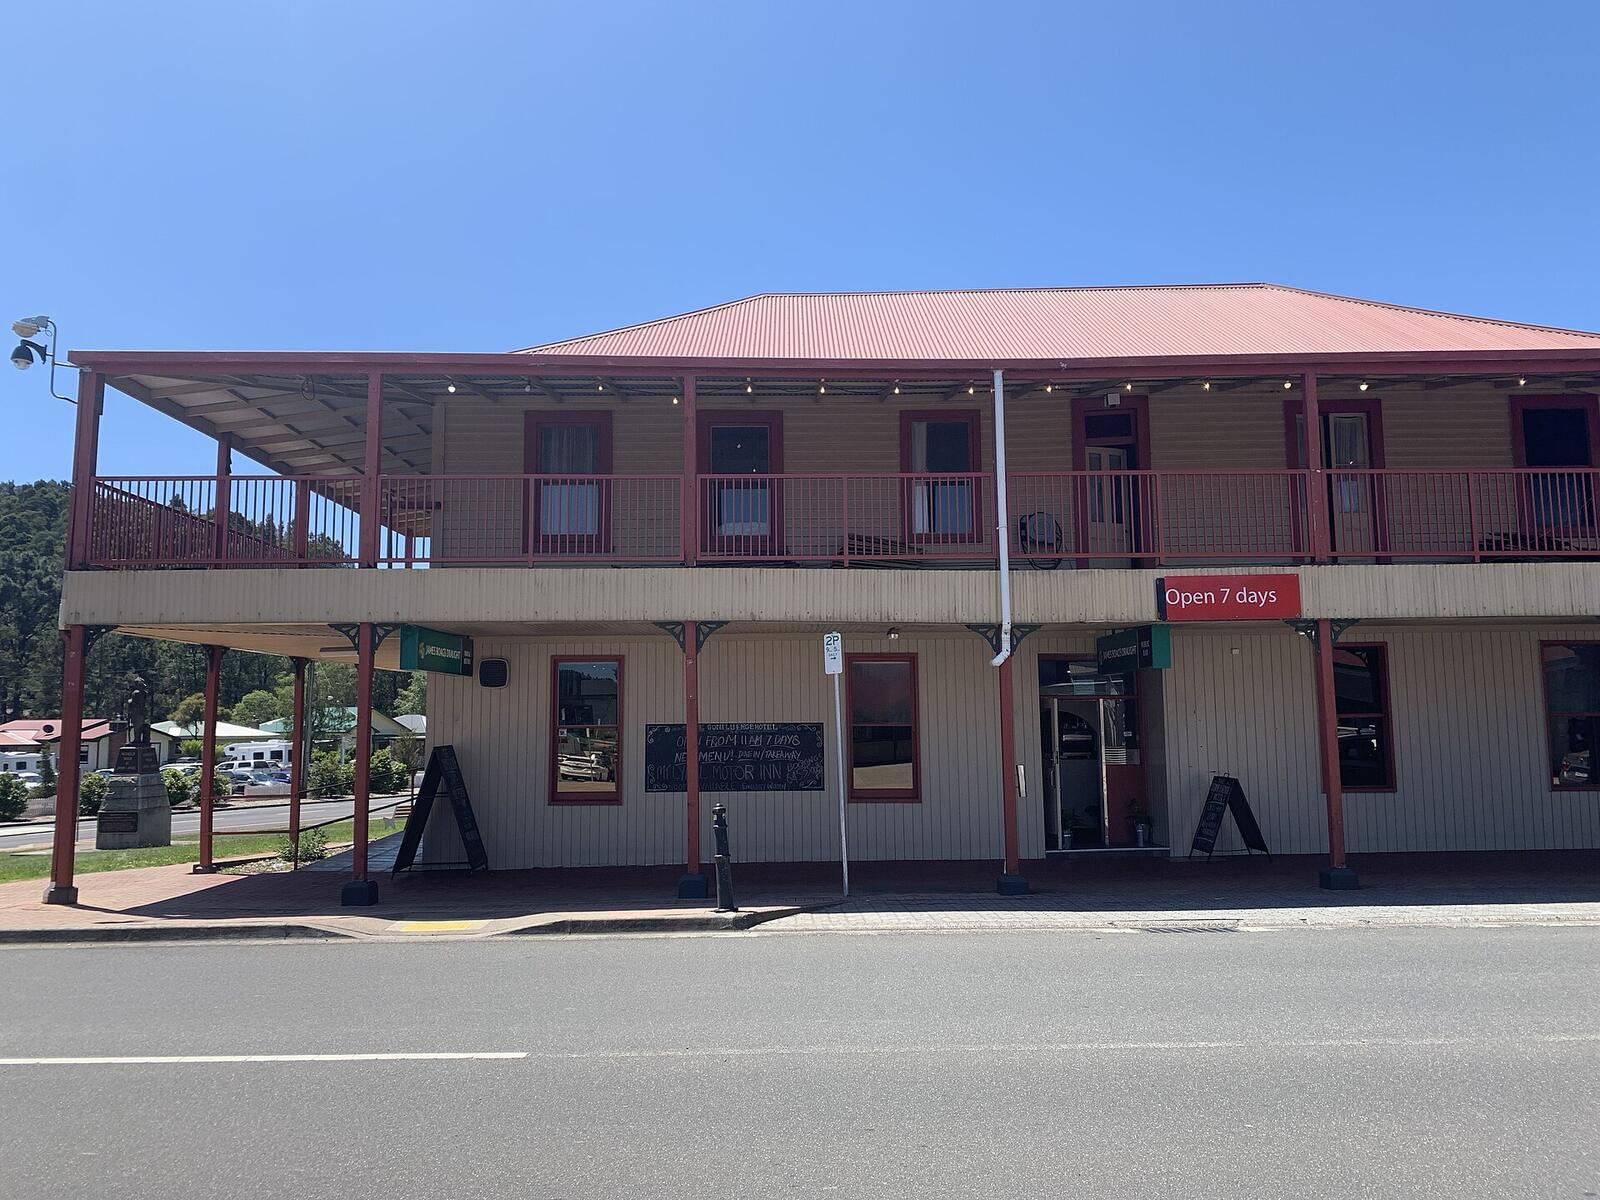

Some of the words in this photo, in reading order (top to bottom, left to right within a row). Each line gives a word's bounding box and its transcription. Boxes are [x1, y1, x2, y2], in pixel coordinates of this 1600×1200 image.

[1166, 588, 1215, 609] Open
[1220, 588, 1230, 603] 7
[1236, 587, 1277, 607] days
[826, 635, 840, 646] 2P
[705, 735, 737, 746] FROM
[766, 735, 773, 746] 7
[774, 735, 801, 746] DAYS
[712, 765, 754, 780] MOTOR
[759, 764, 782, 780] INN
